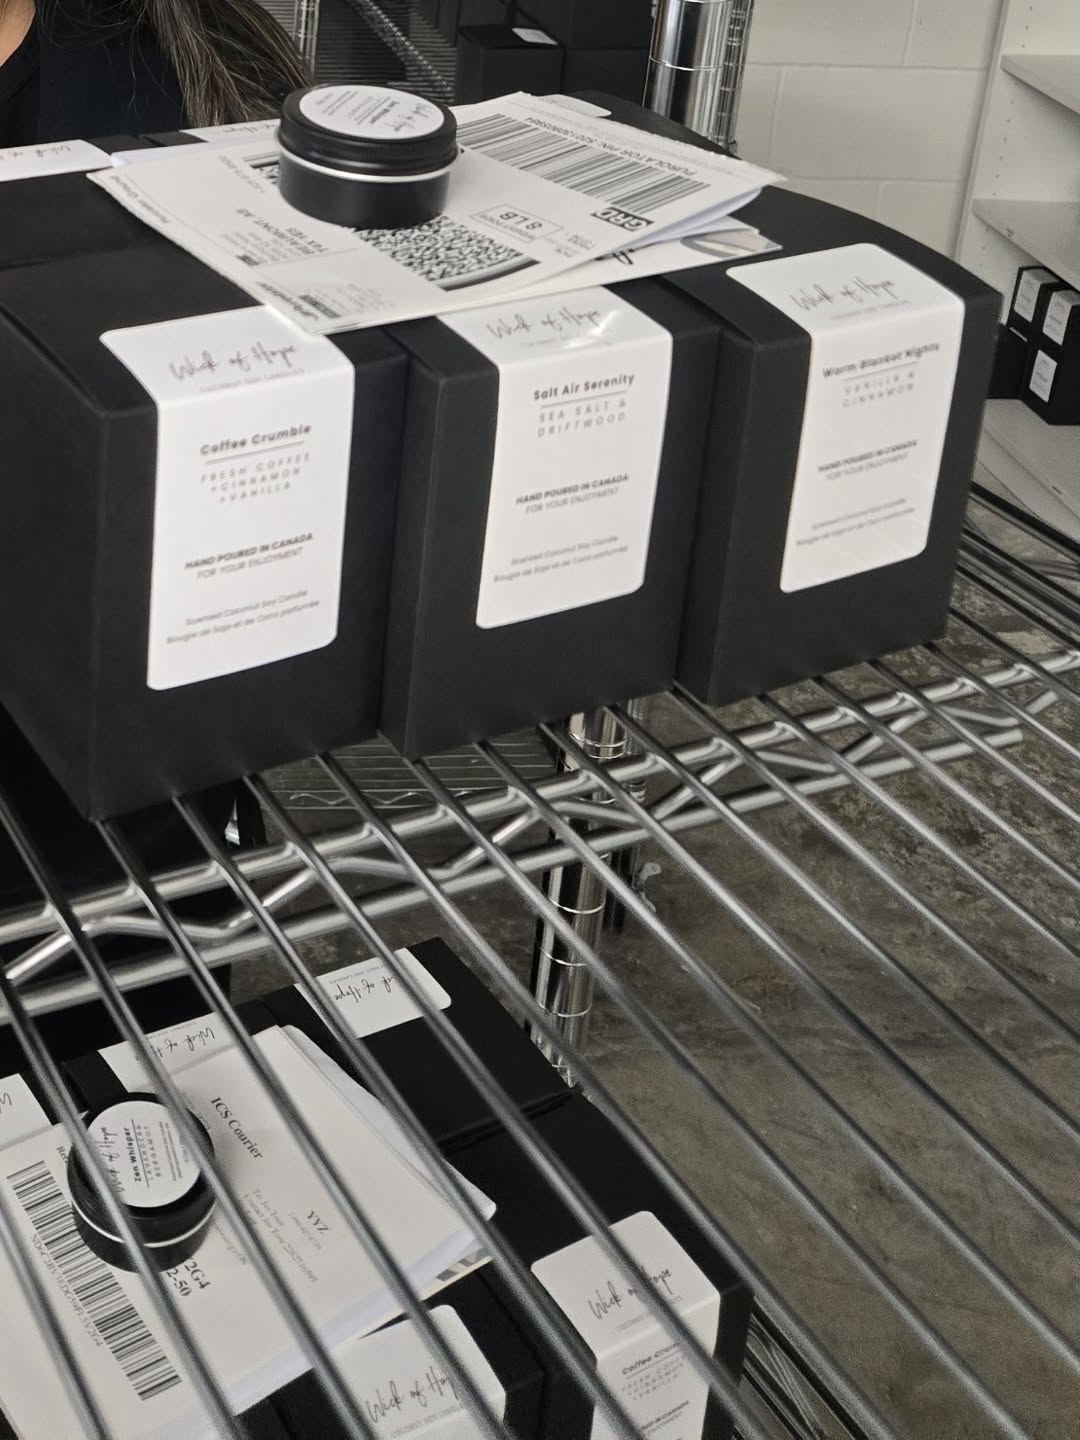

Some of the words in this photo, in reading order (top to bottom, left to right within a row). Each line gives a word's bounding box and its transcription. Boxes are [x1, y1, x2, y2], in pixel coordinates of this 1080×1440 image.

[499, 211, 530, 226] LB
[594, 206, 650, 232] GRD
[790, 282, 834, 311] Wick
[840, 283, 864, 303] of
[853, 275, 896, 300] Hope
[486, 313, 533, 339] Wick
[540, 314, 563, 332] of
[559, 306, 601, 328] Hope
[169, 349, 217, 382] Wick
[229, 350, 251, 373] of
[250, 340, 297, 368] Hope
[823, 363, 857, 378] Warm
[533, 388, 558, 401] Salt
[562, 382, 580, 395] Air
[583, 373, 635, 392] Serenity
[537, 412, 626, 438] DRIFTWOOD
[538, 410, 565, 424] SEA
[575, 400, 609, 416] SALT
[200, 438, 247, 456] Coffee
[250, 423, 312, 447] Crumble
[201, 466, 248, 483] FRESH
[256, 452, 310, 472] COFFEE
[516, 492, 543, 505] HAND
[543, 484, 580, 499] POURED
[591, 473, 629, 488] CANADA
[184, 556, 215, 570] HAND
[217, 546, 258, 562] POURED
[271, 532, 313, 550] CANADA
[220, 561, 246, 574] YOUR
[248, 546, 304, 568] ENJOYMENT
[334, 983, 361, 1003] Hope
[183, 1025, 216, 1052] Wick
[95, 1127, 119, 1148] Hope
[210, 1096, 233, 1120] ICS
[228, 1119, 264, 1159] Courier
[123, 1127, 137, 1164] Whisper
[133, 1165, 142, 1183] Zen
[306, 1209, 329, 1233] YYZ
[184, 1260, 211, 1290] 2G4
[587, 1280, 625, 1320] Wick
[621, 1356, 652, 1375] Coffee
[365, 1380, 403, 1423] Wick
[409, 1380, 428, 1408] of
[426, 1365, 460, 1401] Hop
